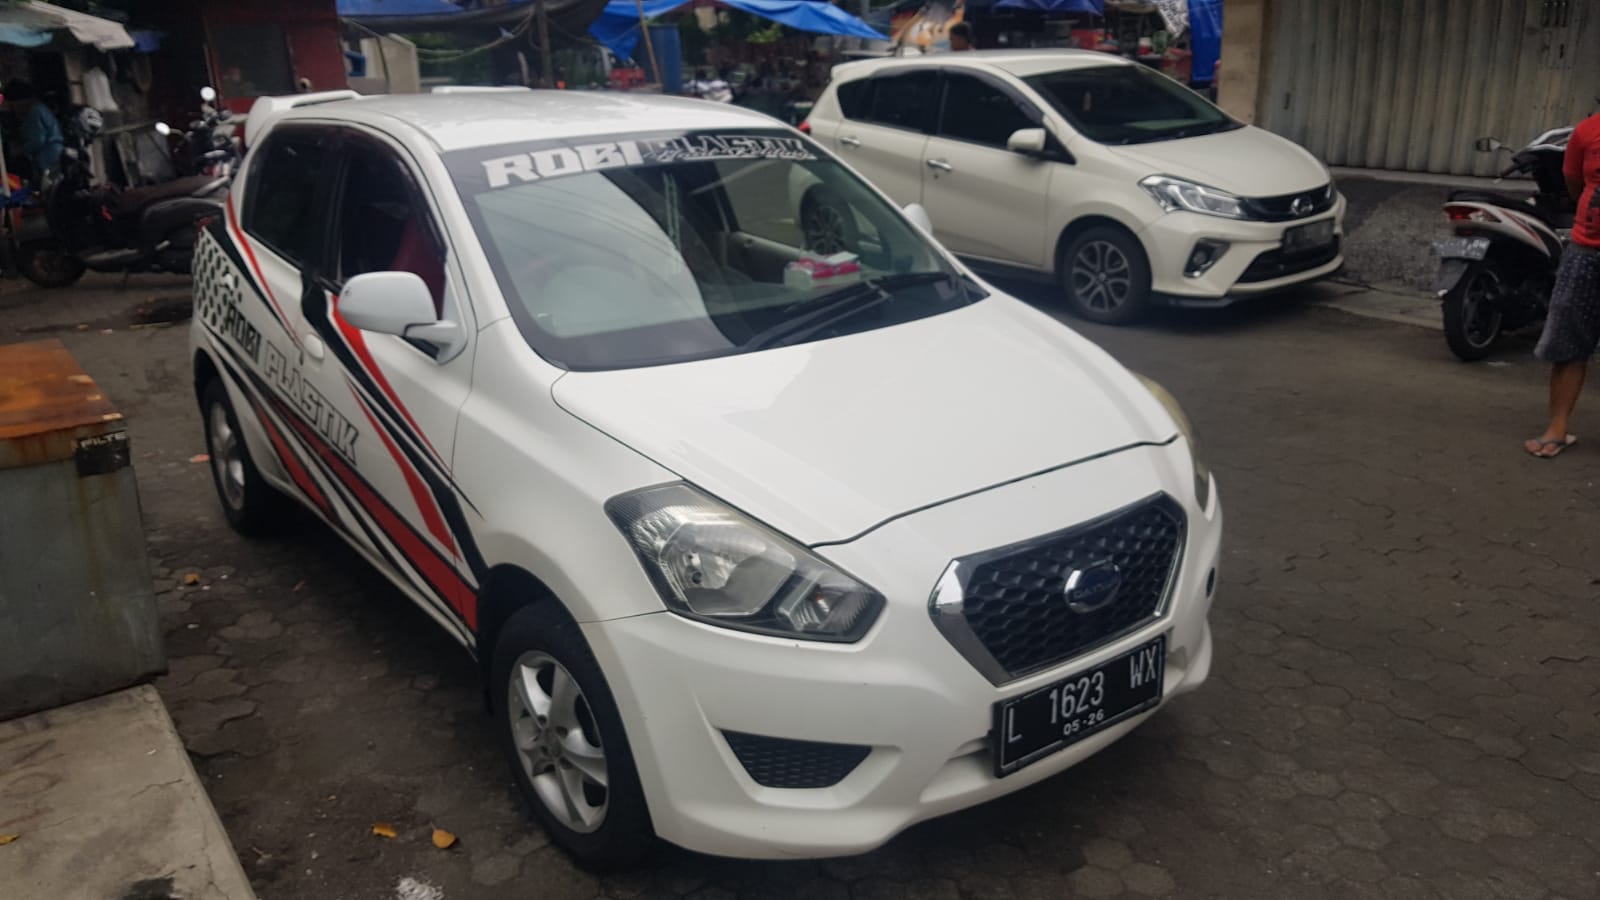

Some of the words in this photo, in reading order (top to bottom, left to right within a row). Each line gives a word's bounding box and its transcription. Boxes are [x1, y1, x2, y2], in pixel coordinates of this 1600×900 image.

[481, 141, 645, 188] ROBI
[224, 302, 262, 364] ROBI
[264, 340, 359, 466] PLASTIK
[1008, 708, 1022, 743] L
[1050, 671, 1105, 724] 1623
[1130, 645, 1158, 689] WX
